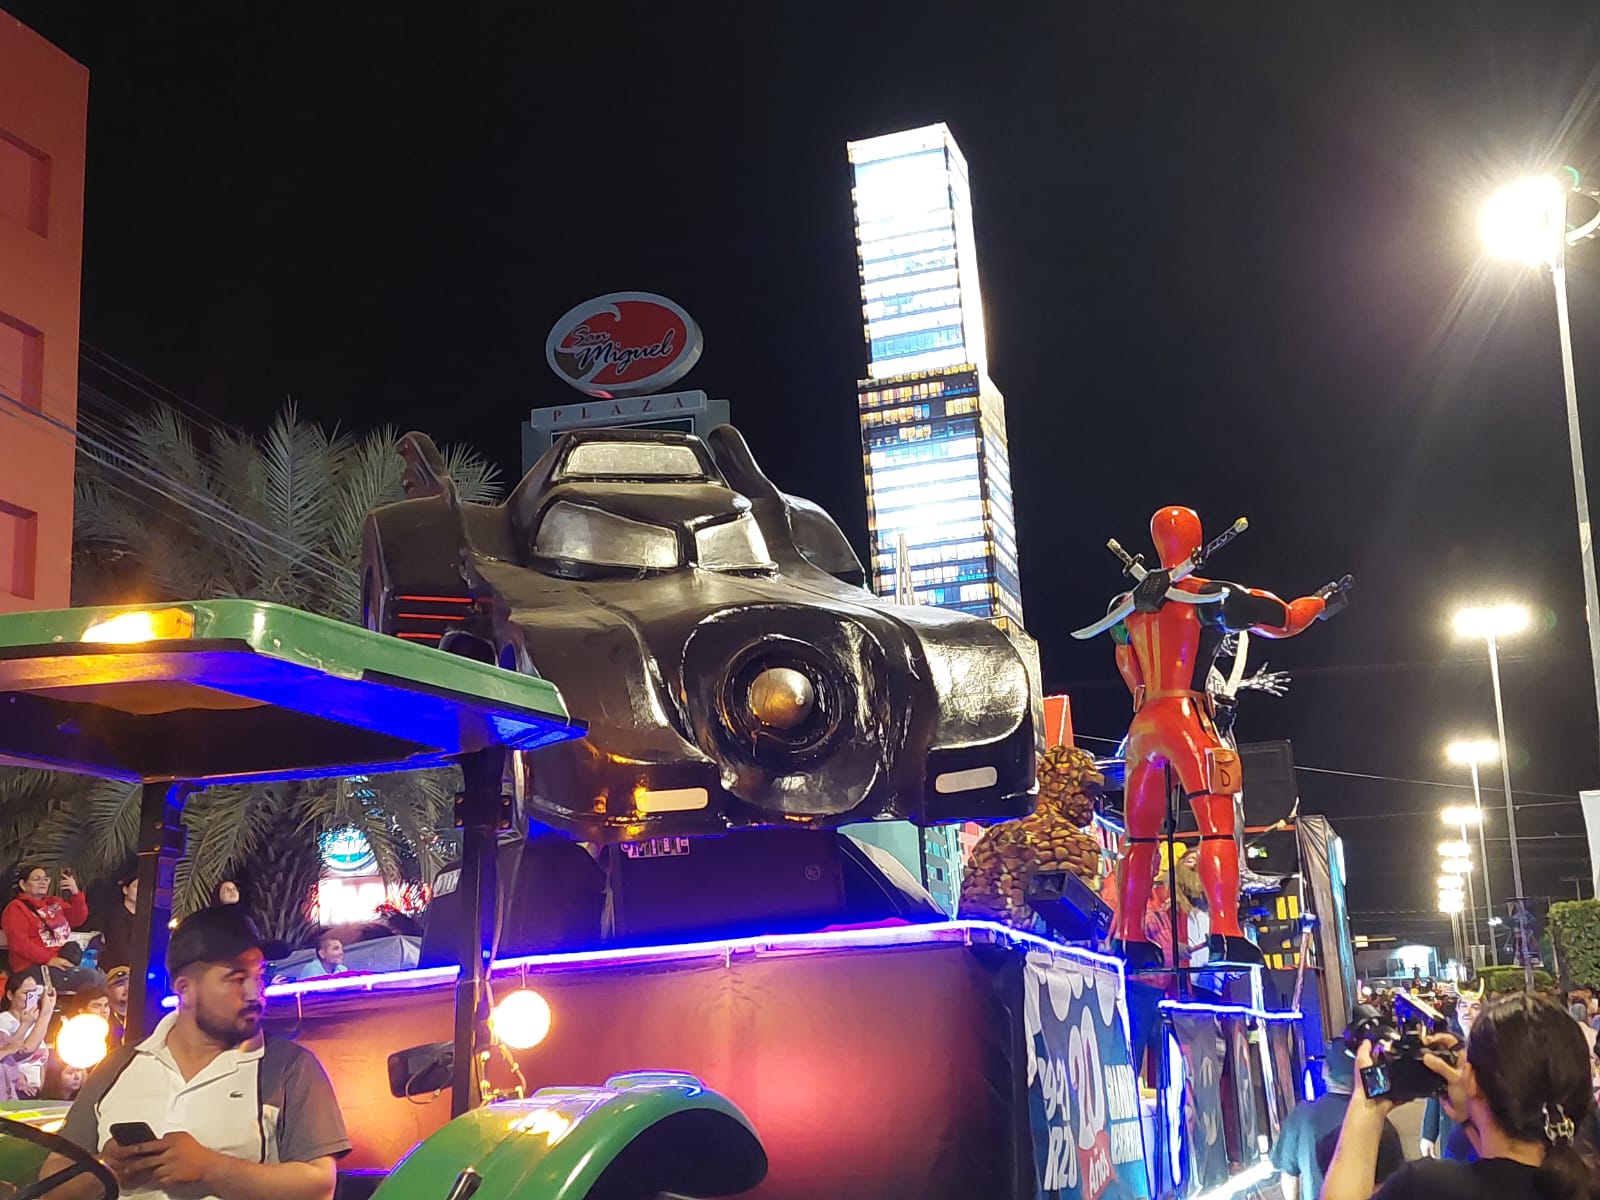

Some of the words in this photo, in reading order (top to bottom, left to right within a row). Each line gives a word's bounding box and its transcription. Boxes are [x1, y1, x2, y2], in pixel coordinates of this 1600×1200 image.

[572, 325, 611, 346] San
[576, 328, 675, 375] Miguel
[552, 396, 685, 422] PLAZA
[1088, 1145, 1110, 1199] Años
